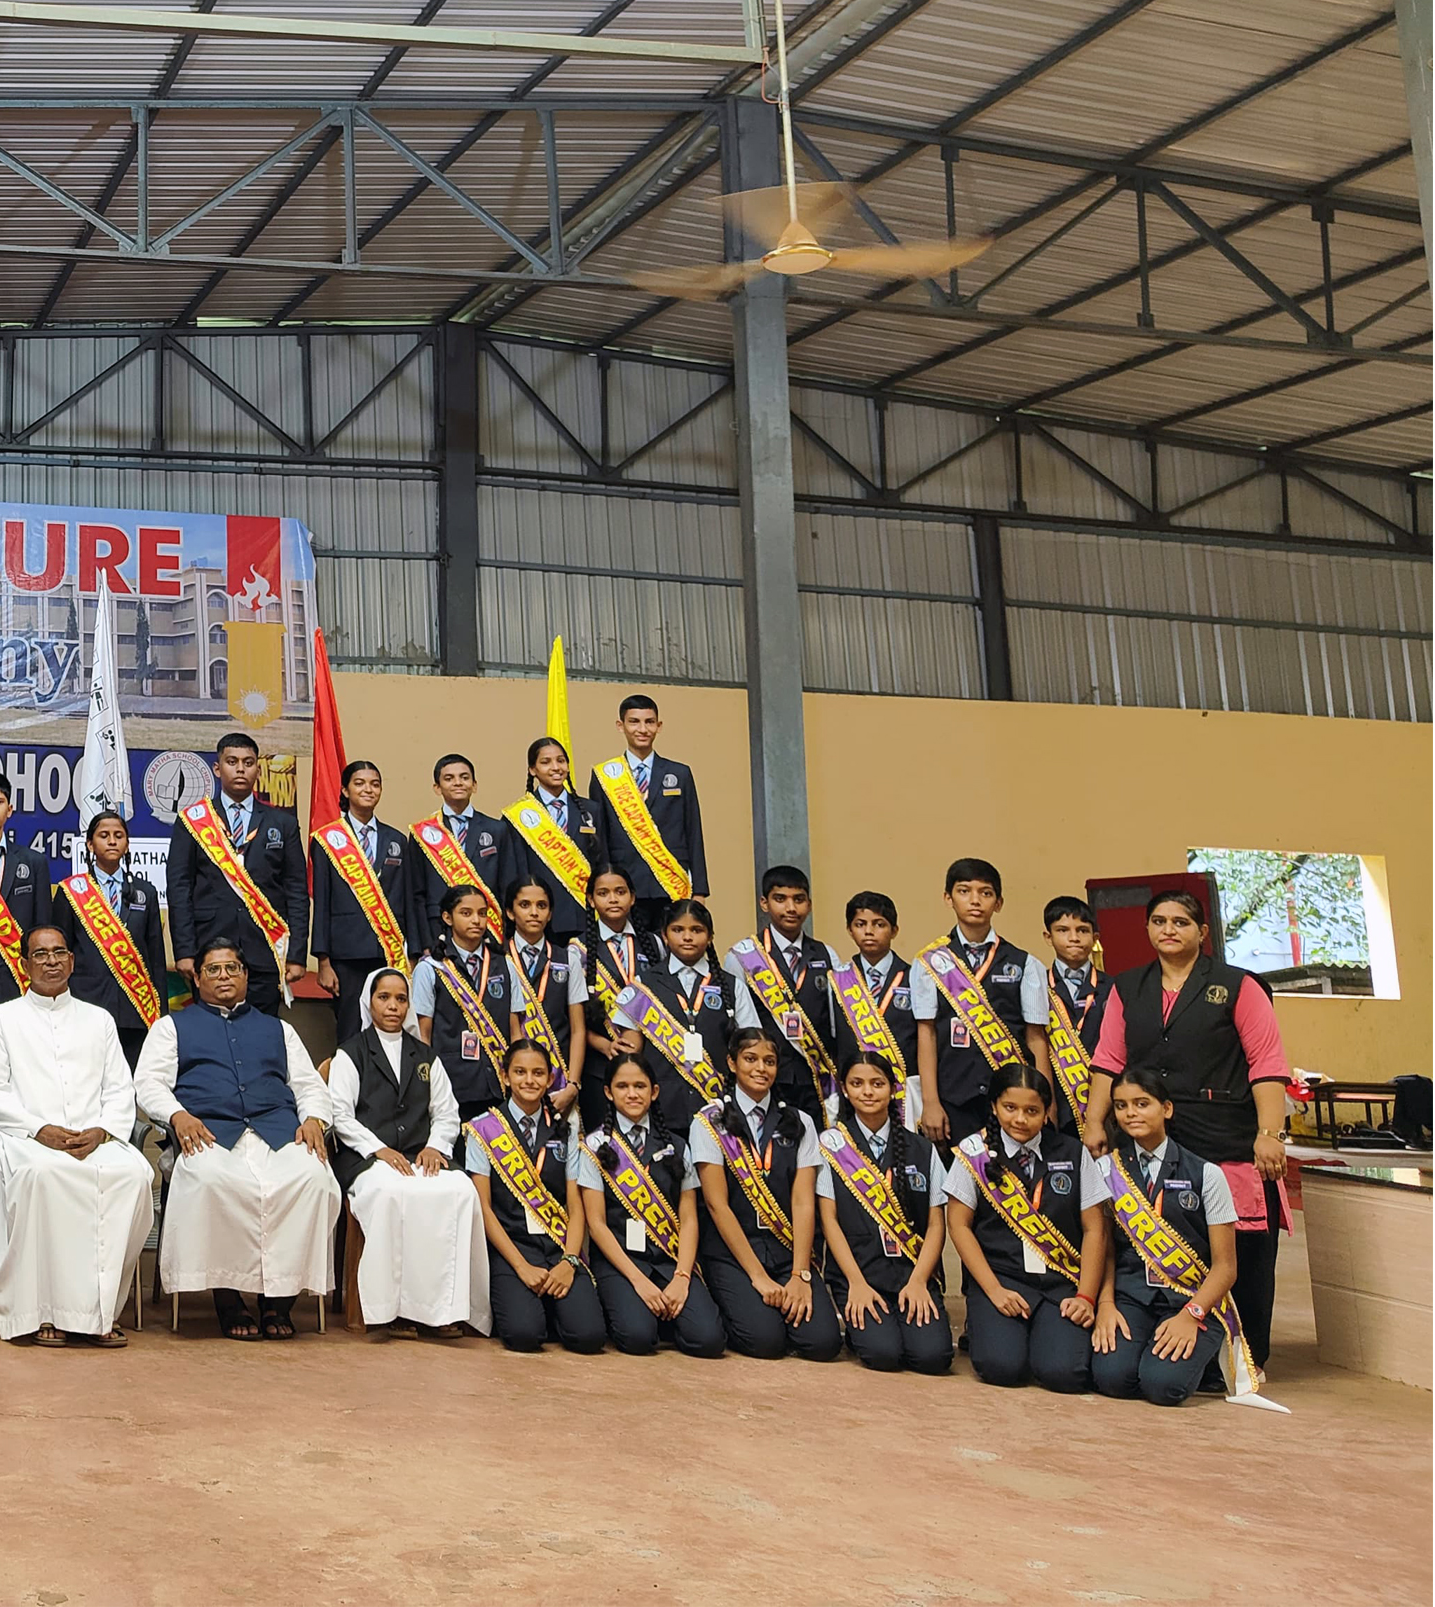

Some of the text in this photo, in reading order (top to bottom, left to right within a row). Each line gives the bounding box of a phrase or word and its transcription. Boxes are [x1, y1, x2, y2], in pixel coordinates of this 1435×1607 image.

[151, 755, 171, 774] MATHA
[172, 752, 201, 767] SCHOOL
[200, 766, 212, 798] CHIPLU
[340, 854, 378, 909] CAPTAIN
[438, 844, 462, 873] VICE
[538, 830, 578, 873] CAPTAIN
[83, 895, 118, 941] VICE
[109, 941, 156, 1019] CAPTAIN
[642, 1006, 722, 1098] PREEC
[489, 1133, 567, 1237] PREFEC
[616, 1167, 679, 1254] PREFE
[1115, 1192, 1202, 1287] PREFE
